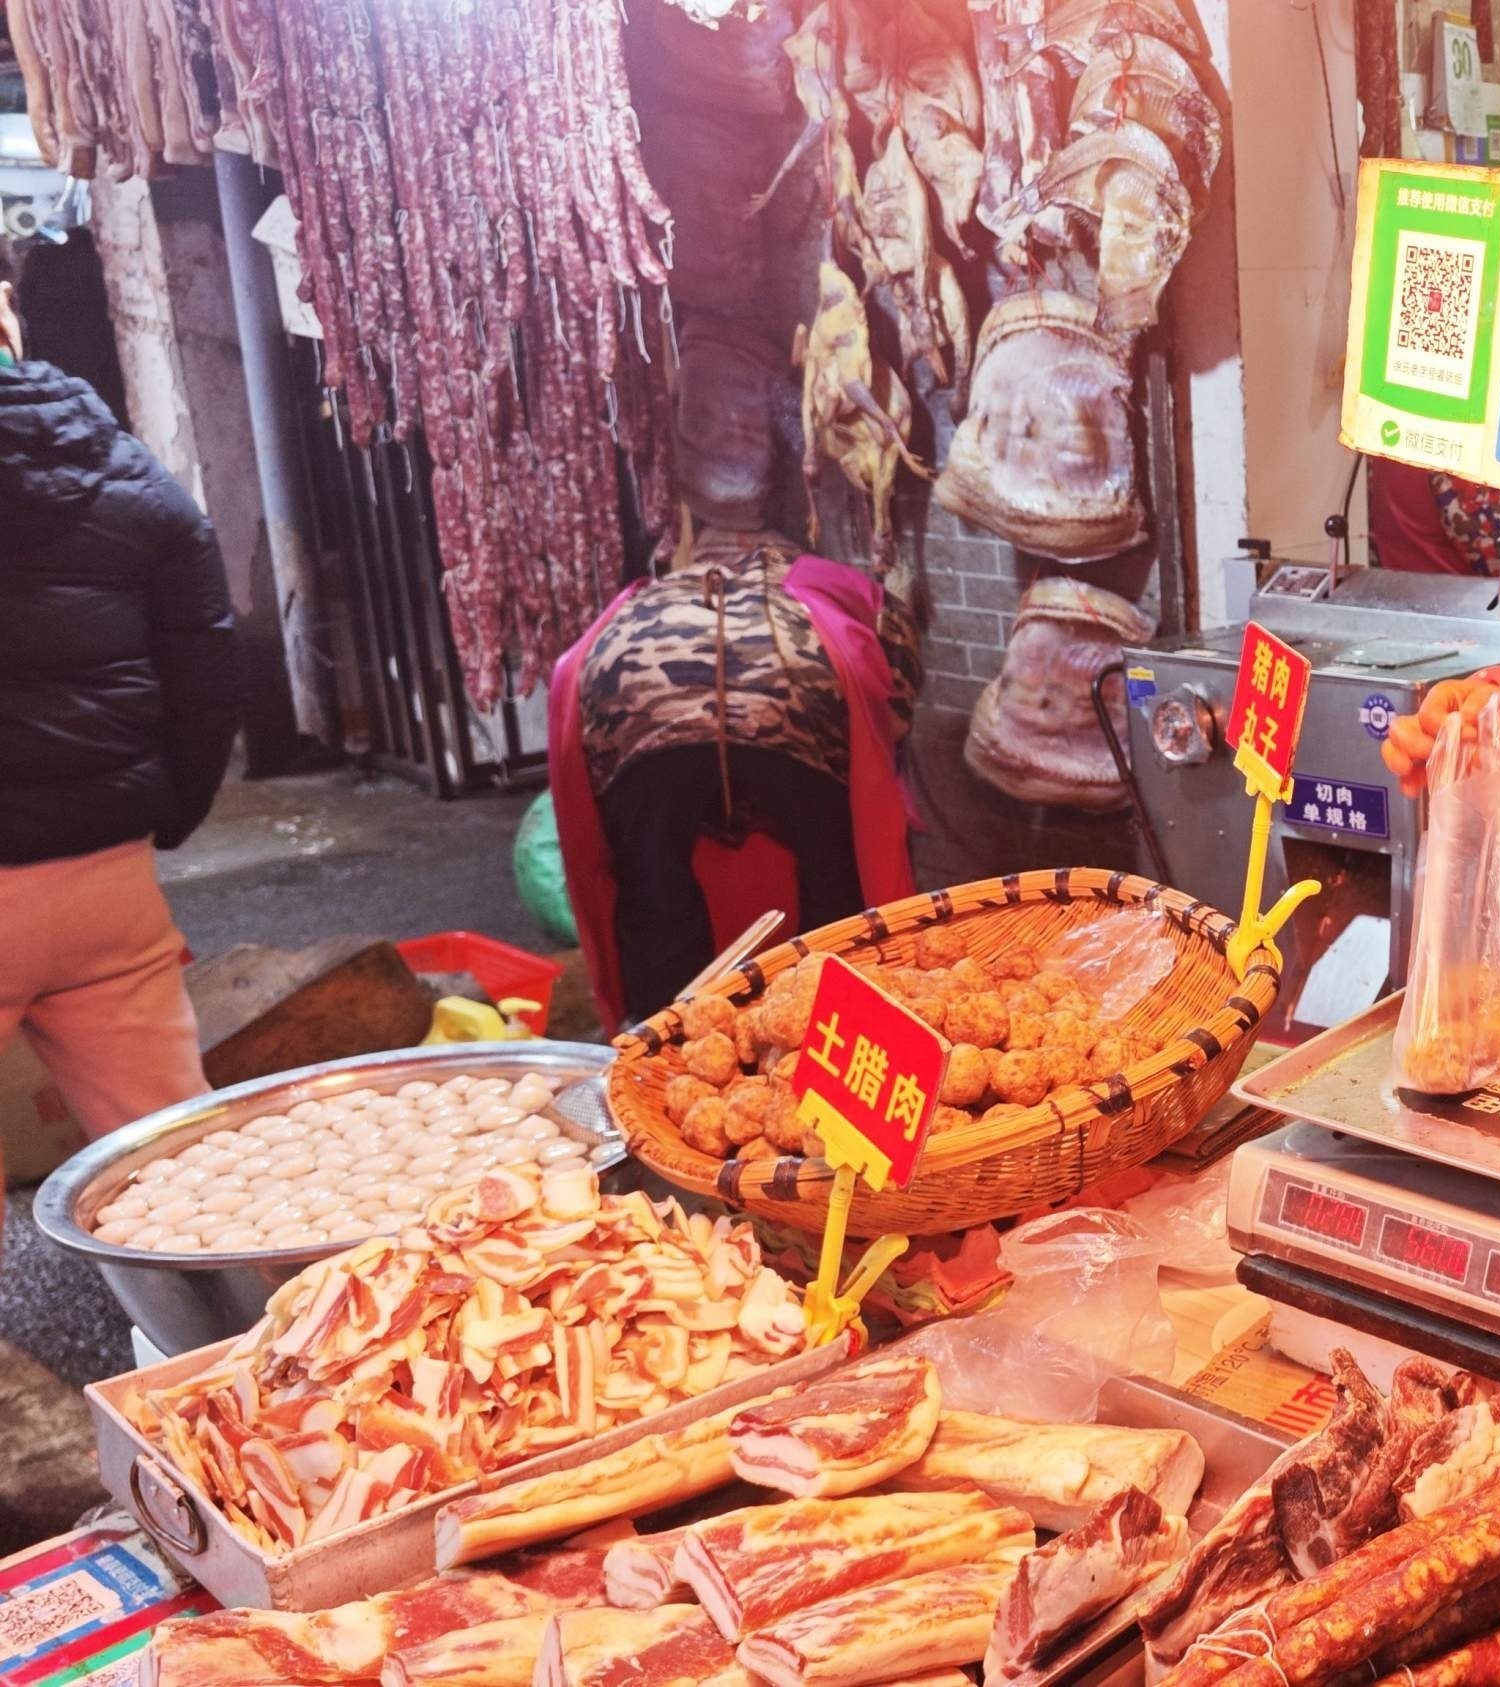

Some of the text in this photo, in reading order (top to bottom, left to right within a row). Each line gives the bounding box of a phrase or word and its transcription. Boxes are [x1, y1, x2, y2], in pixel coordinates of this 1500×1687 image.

[1451, 37, 1473, 80] 30
[1396, 187, 1497, 218] 推荐使用微信支付
[1405, 429, 1463, 461] 微信支付
[1251, 639, 1291, 710] 猪肉
[1238, 702, 1279, 760] 丸子
[1315, 782, 1353, 806] 切肉
[1303, 803, 1367, 831] 单规格
[807, 1012, 927, 1142] 土腊肉
